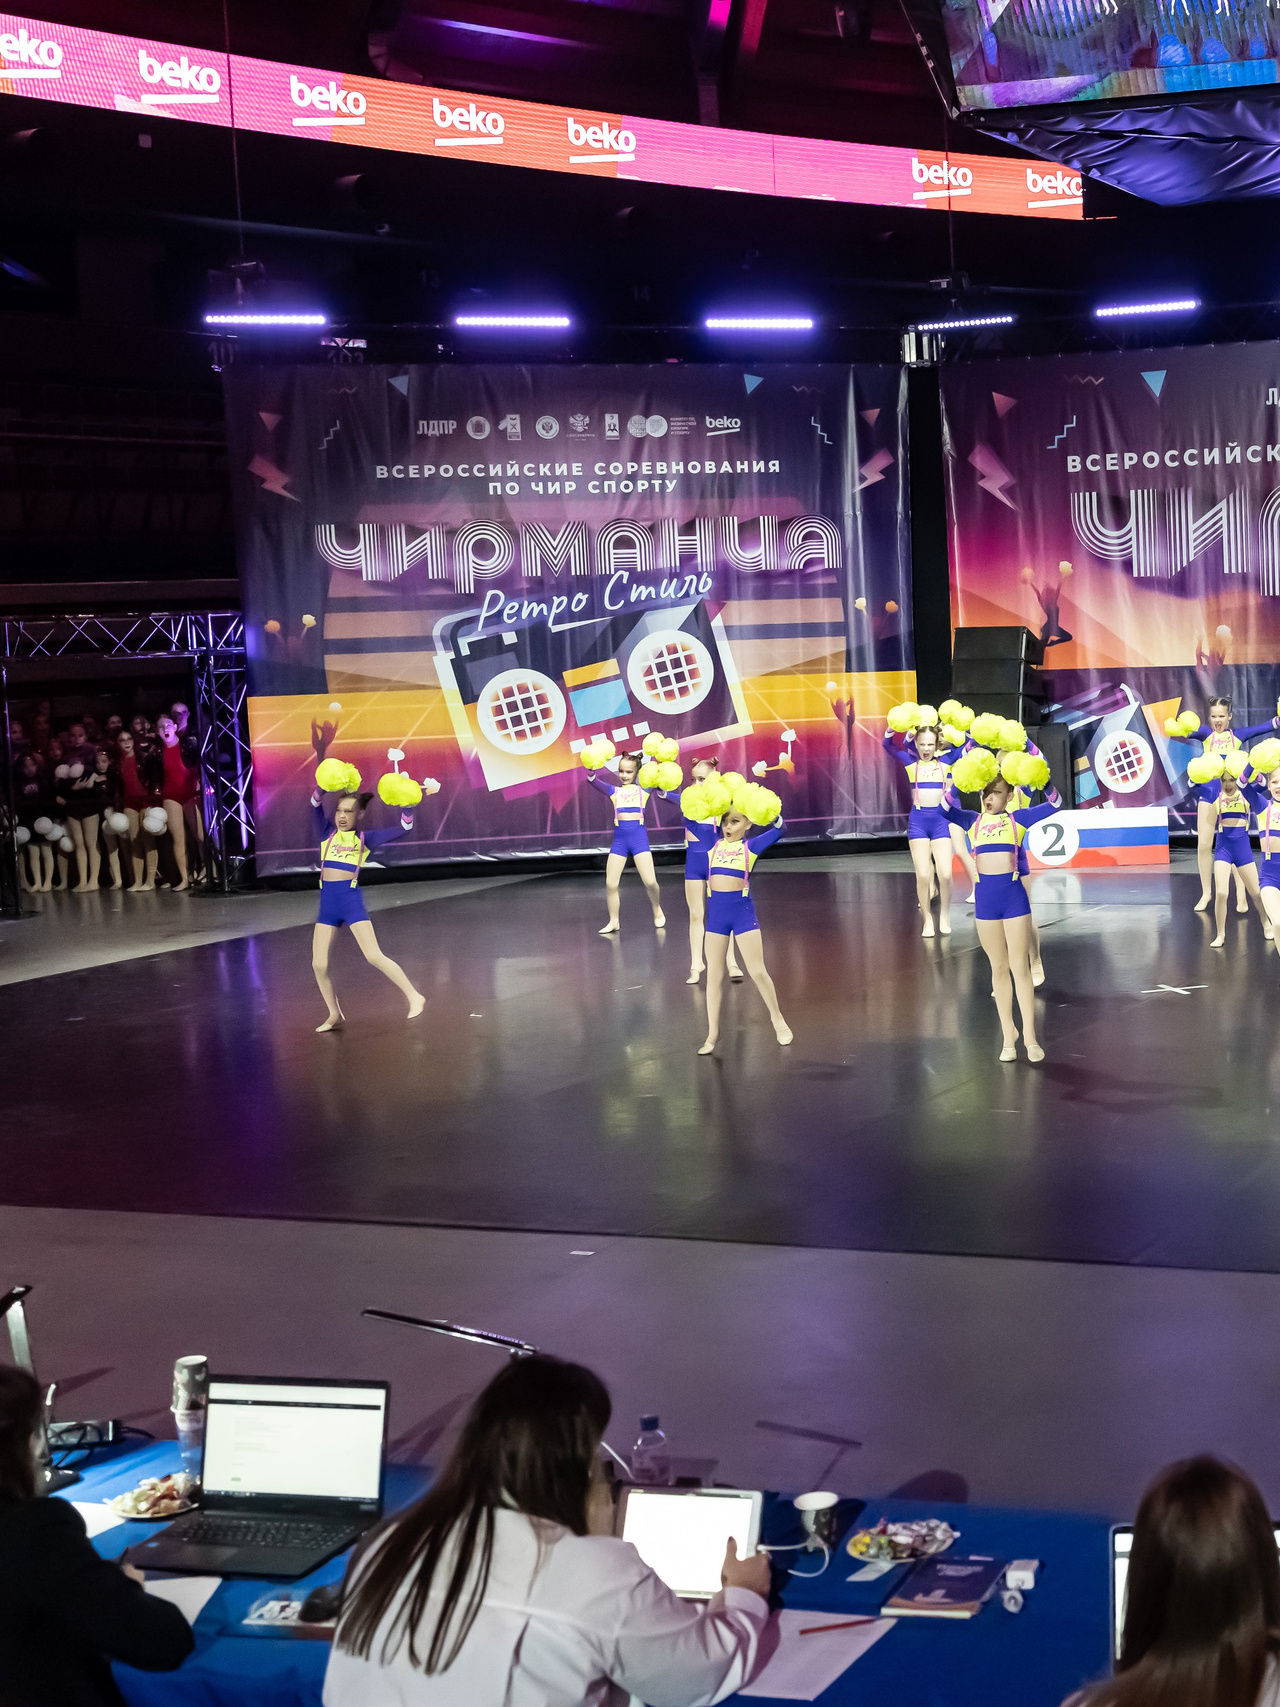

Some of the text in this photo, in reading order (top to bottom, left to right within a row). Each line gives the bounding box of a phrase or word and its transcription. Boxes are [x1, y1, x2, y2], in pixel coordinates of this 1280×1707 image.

[138, 49, 221, 93] beko
[290, 75, 367, 115] beko
[432, 98, 505, 137] beko
[567, 118, 636, 153] beko
[911, 158, 973, 188] beko
[417, 420, 457, 436] ЛДПР
[706, 416, 741, 428] beko
[376, 460, 780, 478] ВСЕРОССИЙСКИЕ СОРЕВНОВАНИЯ
[488, 479, 678, 495] ПО ЧИР СПОРТУ
[477, 570, 713, 632] Ретро Стиль
[1041, 823, 1066, 857] 2
